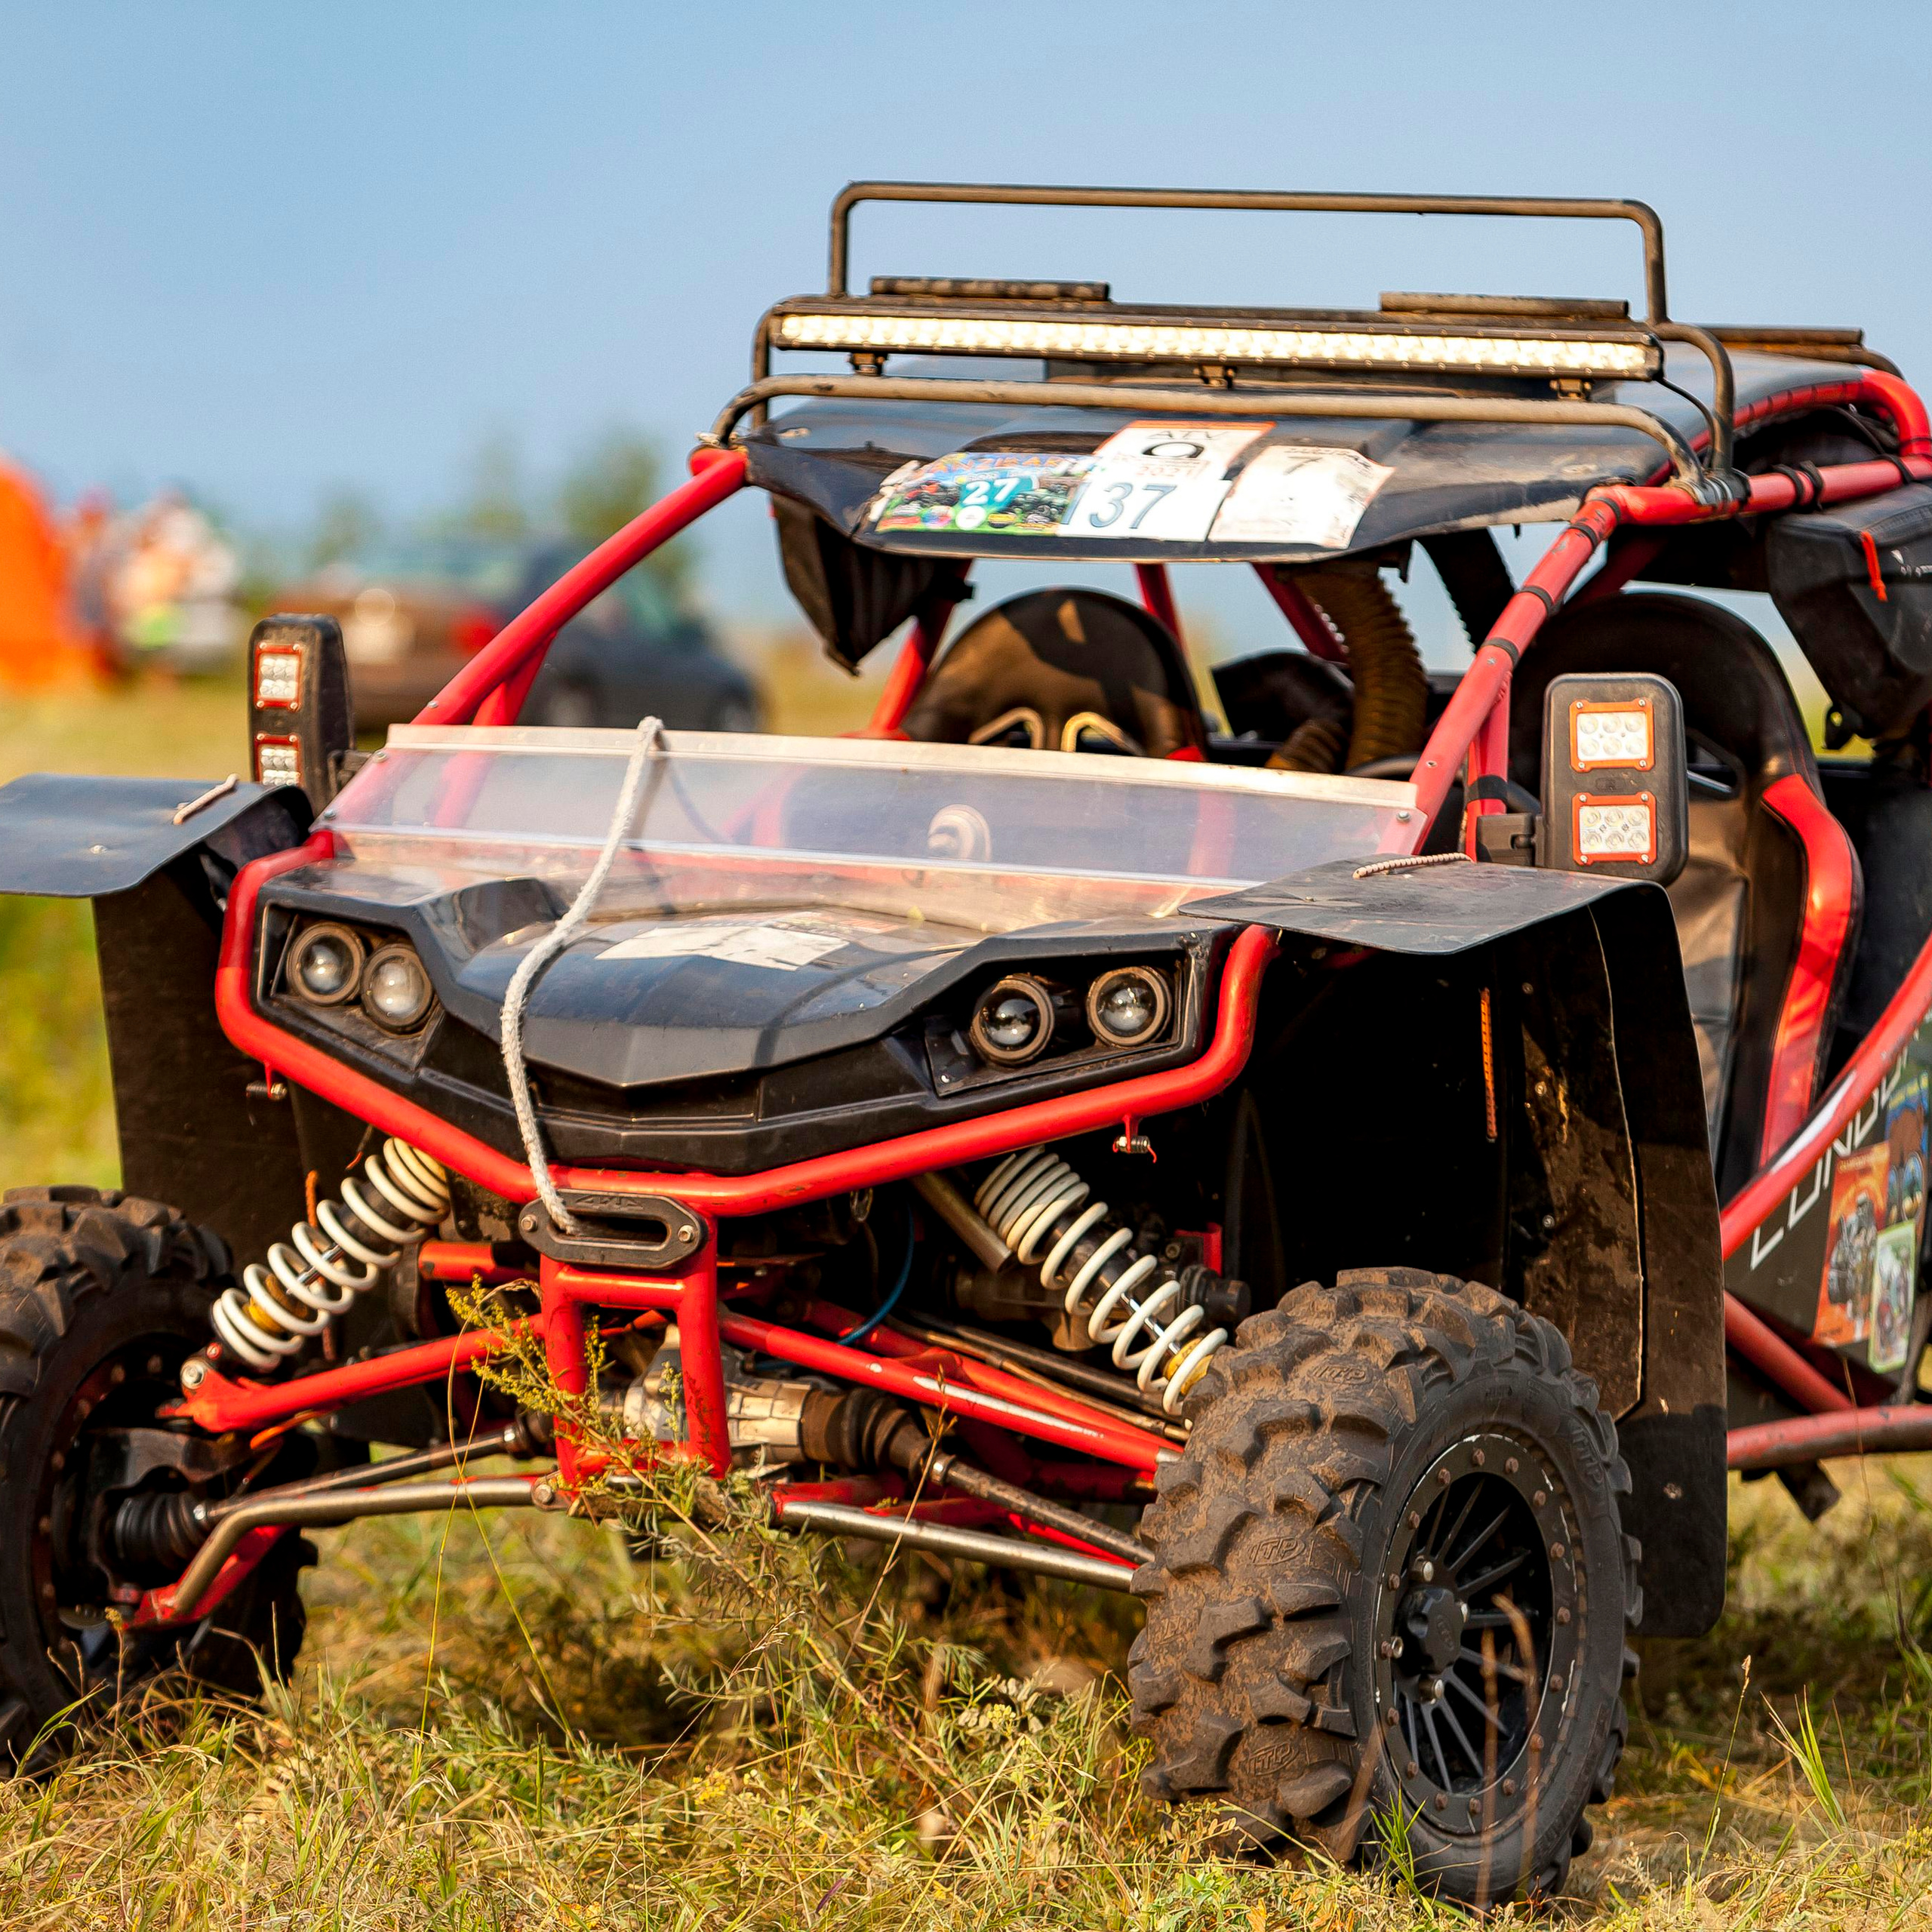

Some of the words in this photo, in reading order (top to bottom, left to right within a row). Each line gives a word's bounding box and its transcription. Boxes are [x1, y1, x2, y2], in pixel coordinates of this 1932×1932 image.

[1147, 430, 1229, 440] ATV
[963, 477, 1020, 505] 27
[1248, 1538, 1297, 1562] ITP
[1245, 1743, 1291, 1775] ITP
